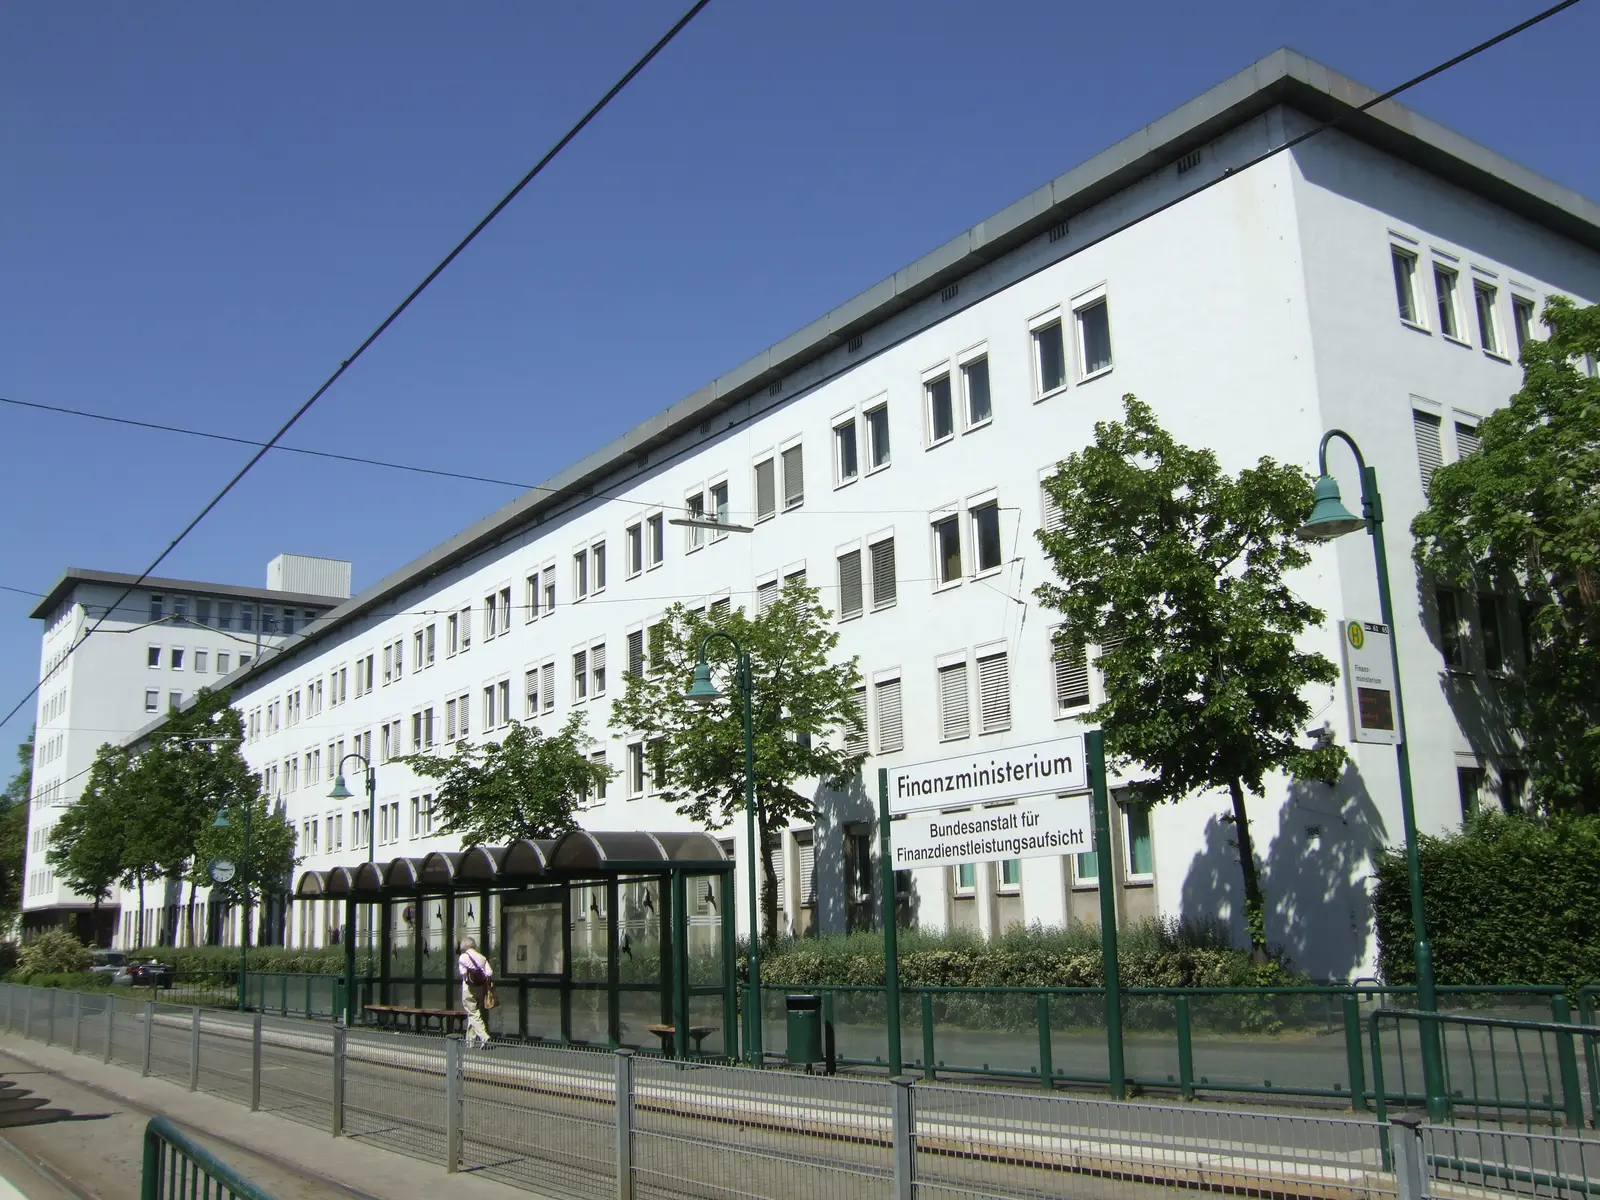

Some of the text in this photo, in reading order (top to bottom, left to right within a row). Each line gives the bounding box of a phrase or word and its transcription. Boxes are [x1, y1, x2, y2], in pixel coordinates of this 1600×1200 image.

[1351, 625, 1360, 644] H
[897, 753, 1073, 798] Finanzministerium
[929, 811, 1040, 838] Bundesanstalt für
[897, 829, 1084, 862] Finanzdienstleistungsaufsicht
